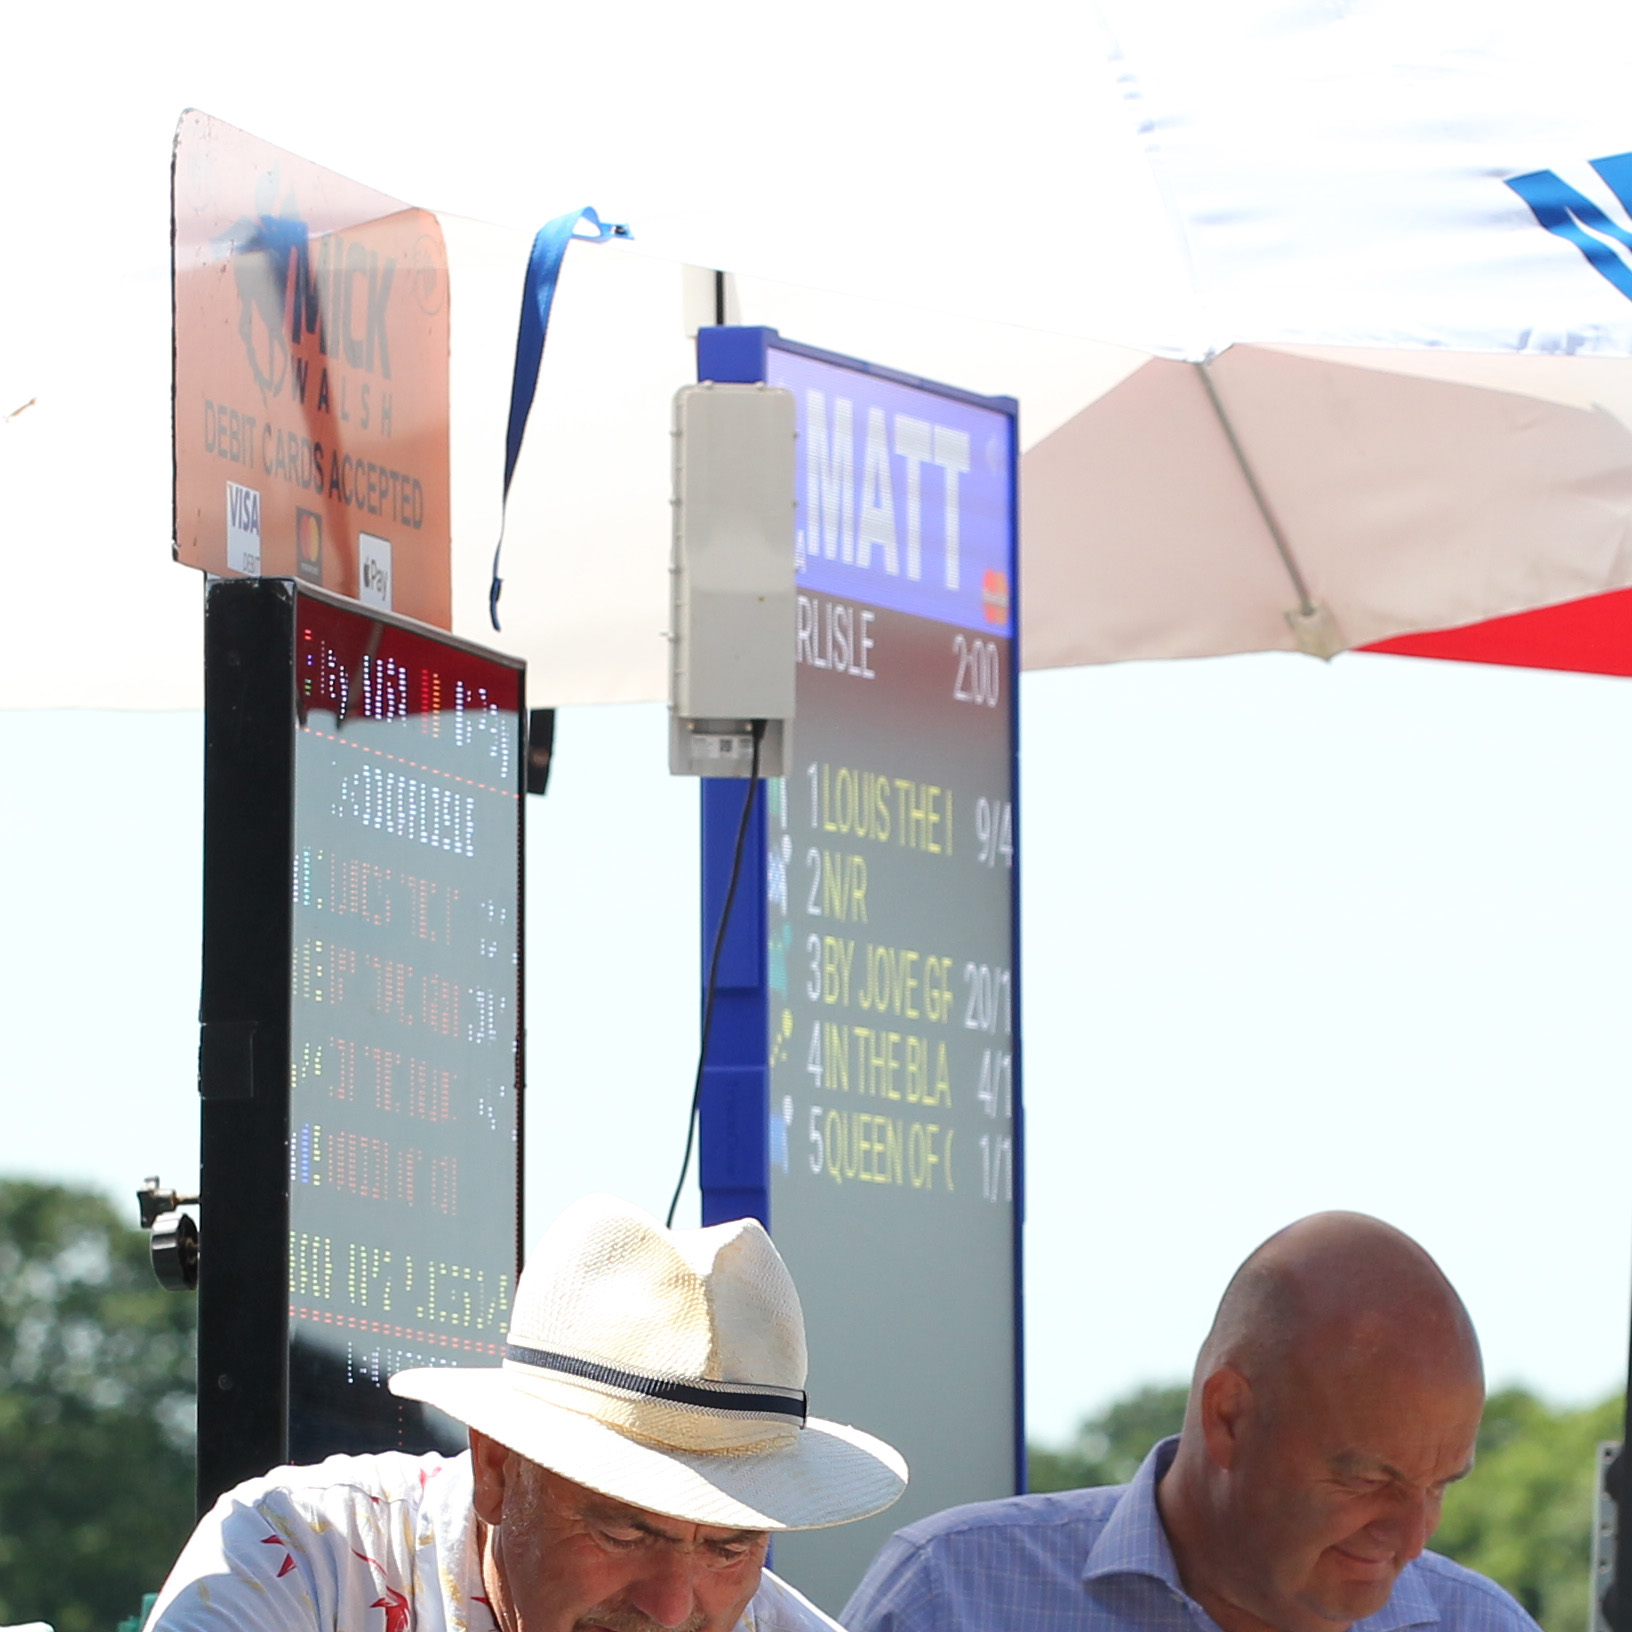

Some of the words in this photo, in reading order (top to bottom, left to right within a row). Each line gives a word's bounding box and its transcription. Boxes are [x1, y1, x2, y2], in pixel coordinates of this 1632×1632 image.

[291, 234, 397, 381] MICK
[292, 354, 393, 437] WALSH
[204, 400, 256, 468] DEBIT
[262, 423, 324, 494] CARDS
[329, 448, 424, 529] ACCEPTED
[806, 388, 971, 590] MATT
[230, 485, 260, 536] VISA
[797, 595, 876, 679] RLISLE
[823, 763, 891, 841] LOUIS
[897, 779, 942, 854] THE
[975, 797, 1013, 868] 9/4
[824, 935, 855, 1007] BY
[859, 942, 918, 1019] JOVE
[824, 1022, 849, 1091] IN
[853, 1026, 901, 1101] THE
[907, 1036, 952, 1110] BLA
[825, 1108, 903, 1186] QUEEN
[909, 1122, 941, 1191] OF
